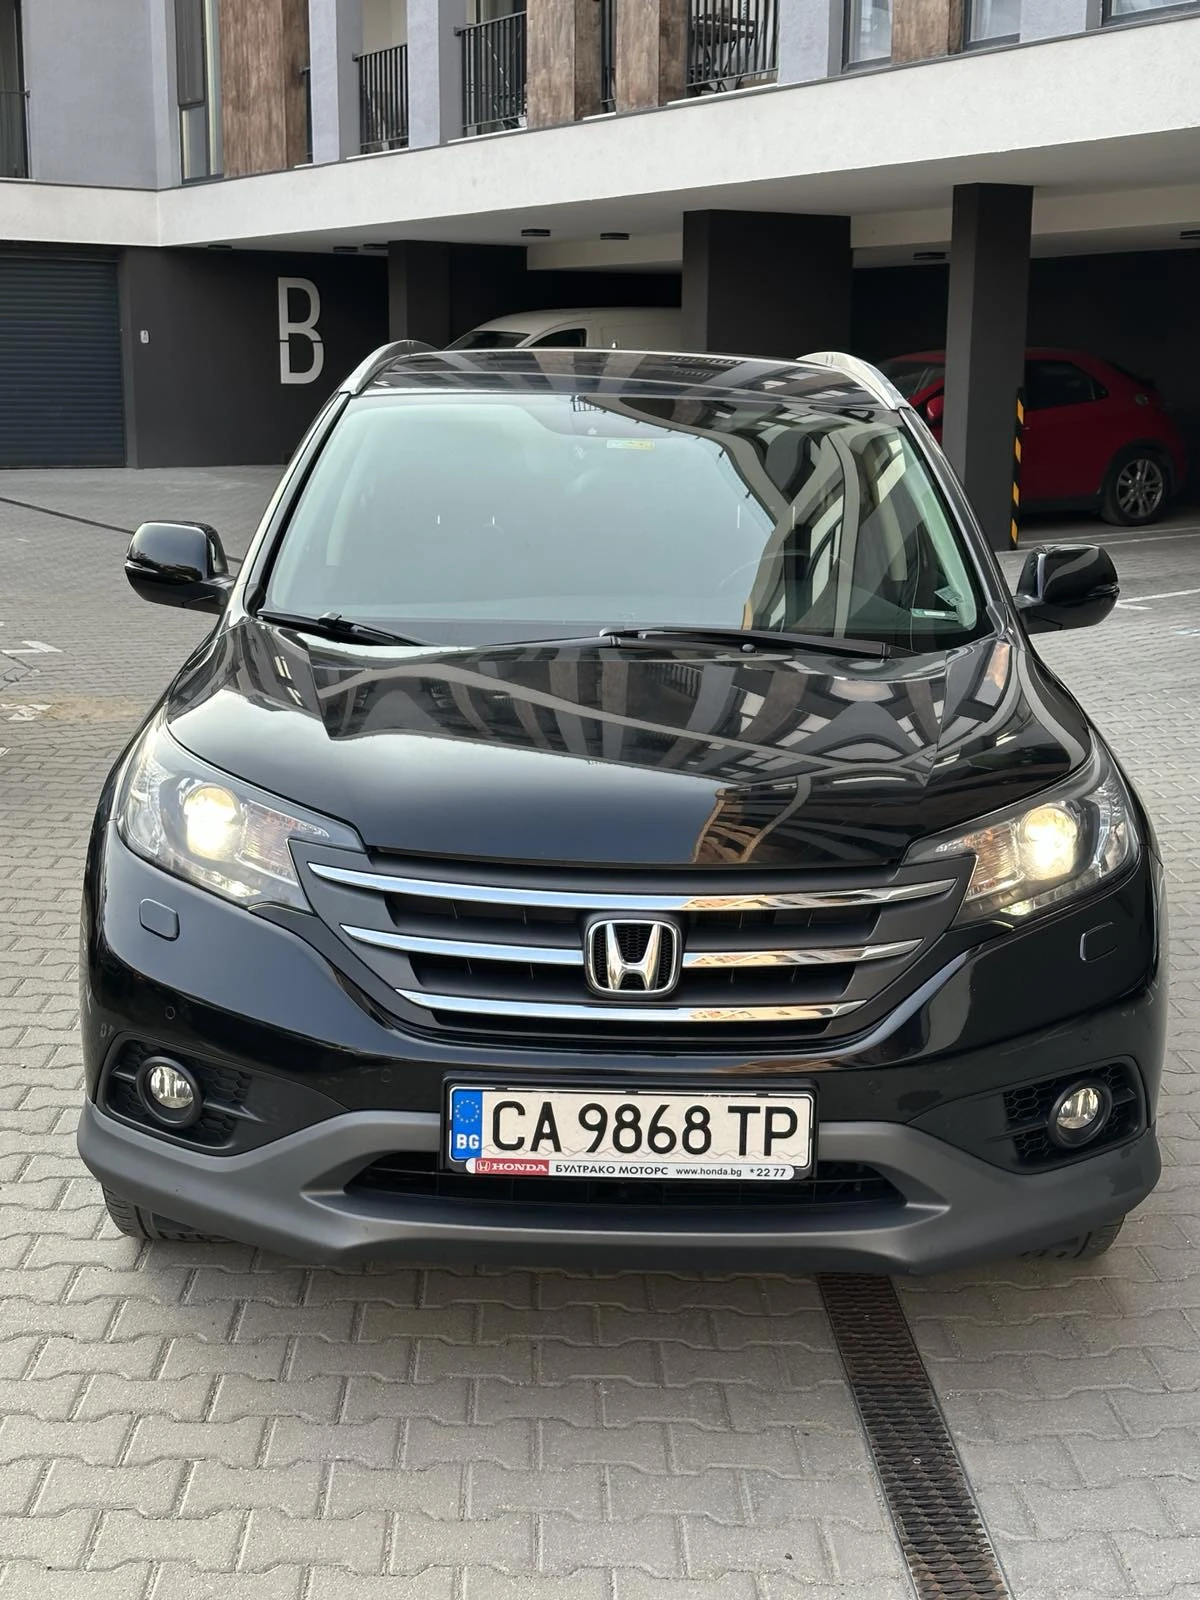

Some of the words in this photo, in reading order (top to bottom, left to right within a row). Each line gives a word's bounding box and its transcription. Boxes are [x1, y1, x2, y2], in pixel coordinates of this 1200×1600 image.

[278, 277, 324, 384] B
[492, 1100, 562, 1153] CA
[578, 1103, 712, 1156] 9868
[727, 1105, 798, 1157] TP
[456, 1134, 480, 1150] BG
[492, 1162, 548, 1172] HONDA
[555, 1164, 616, 1174] БУЛТРАКО
[619, 1166, 668, 1175] МОТОРС
[676, 1167, 742, 1177] www.honda.bg
